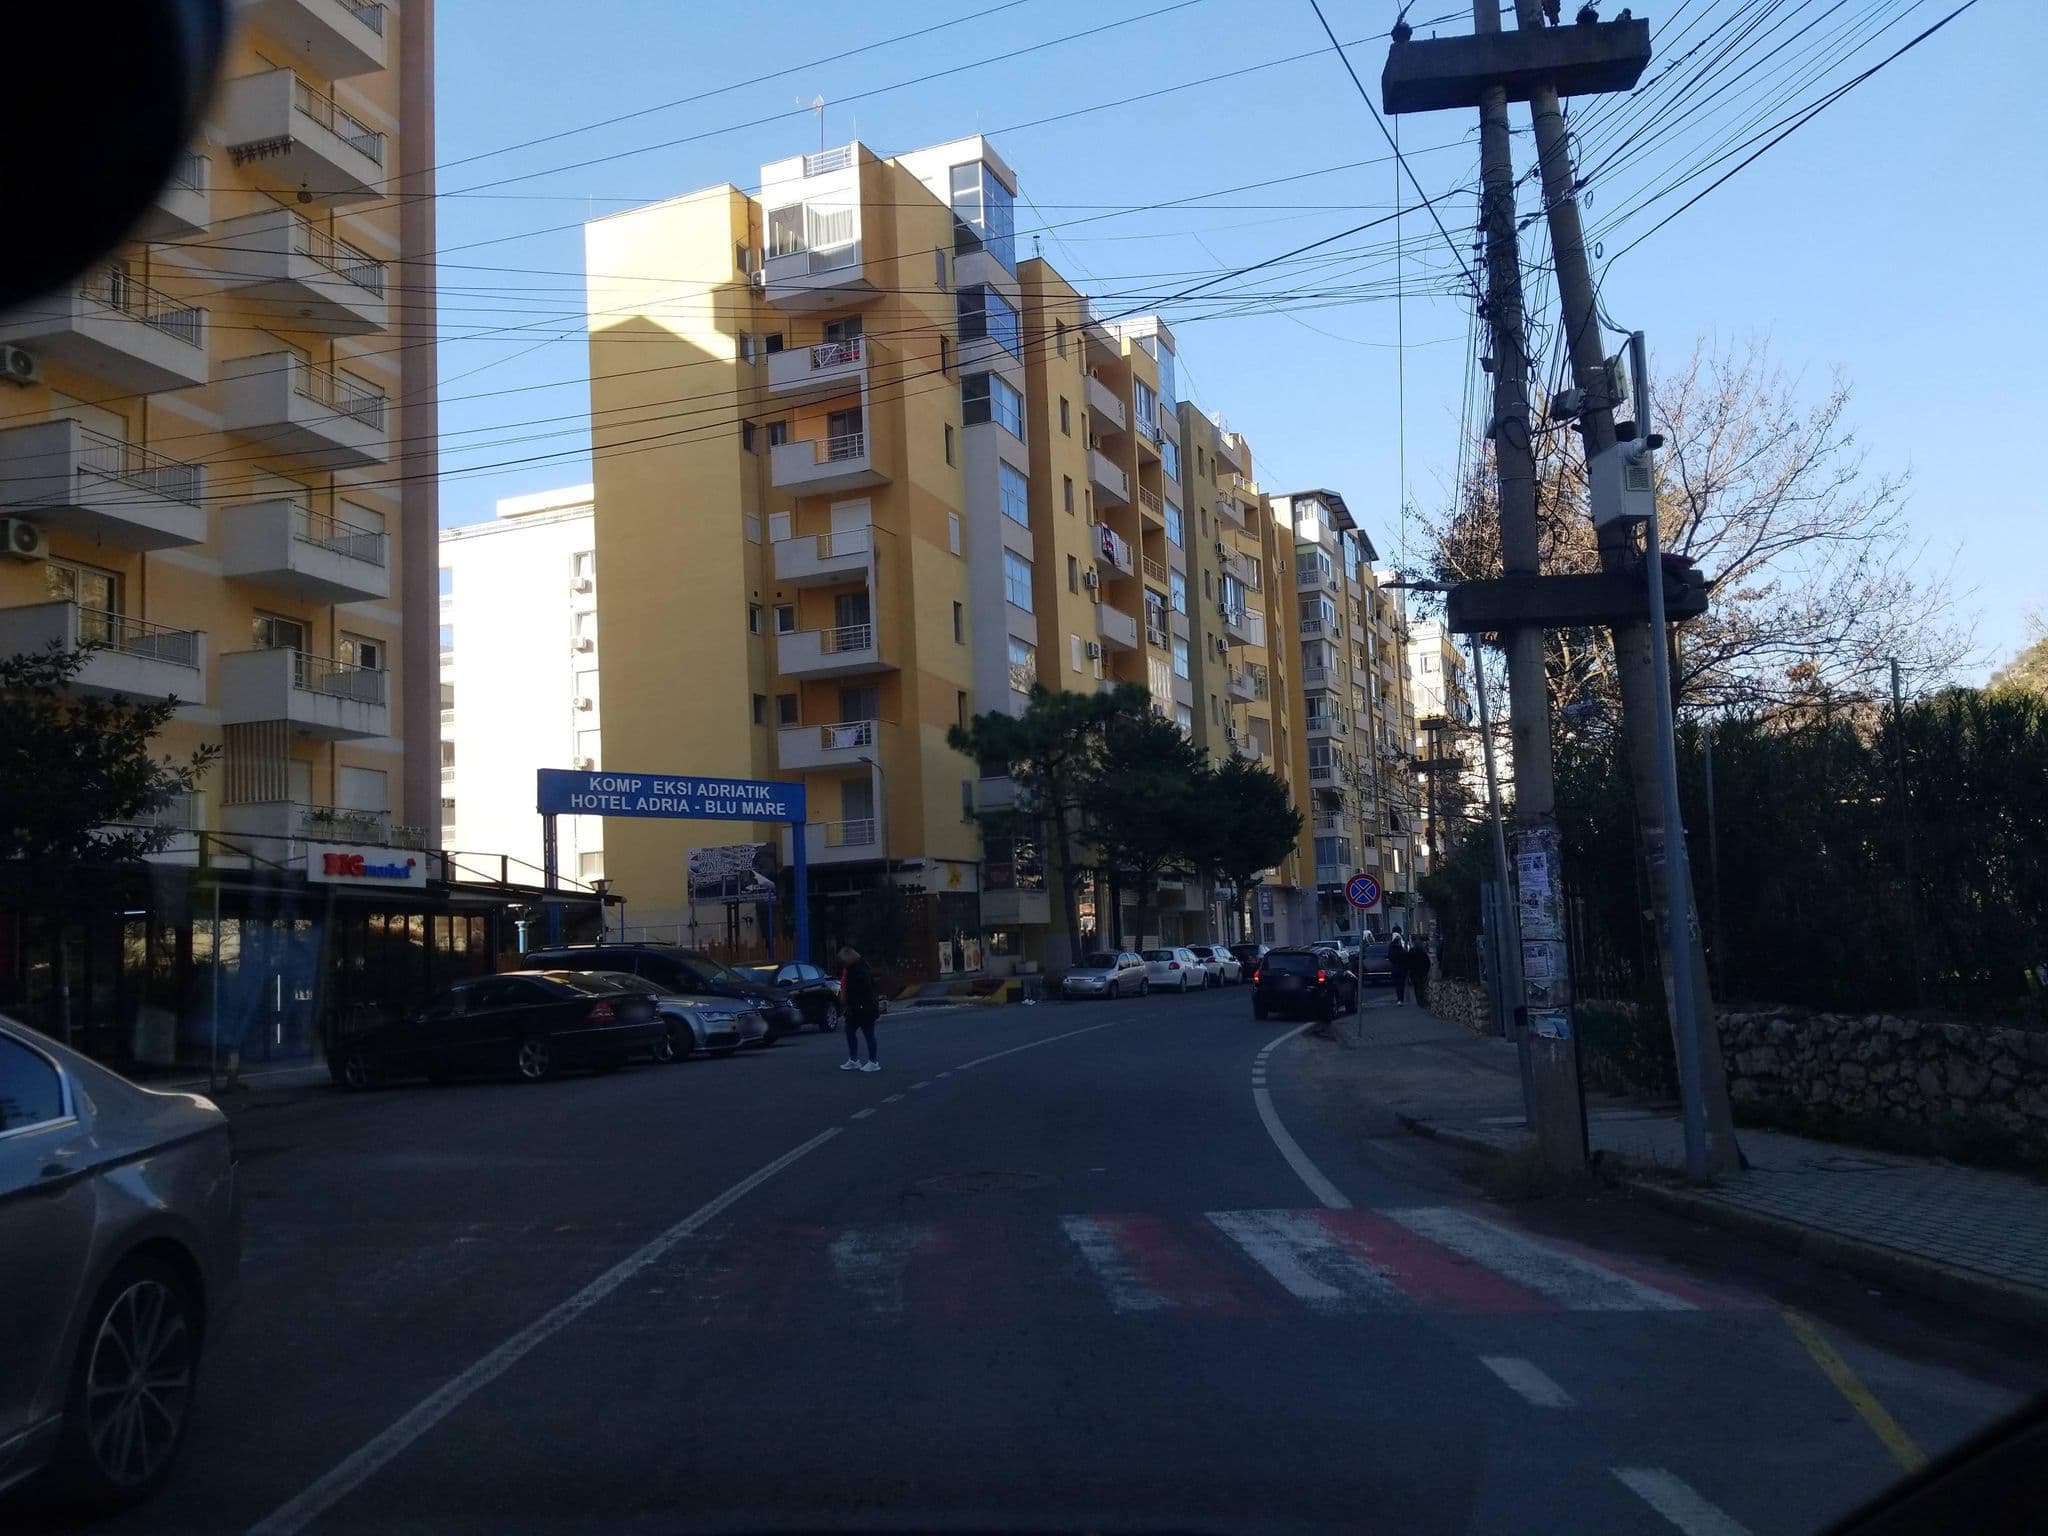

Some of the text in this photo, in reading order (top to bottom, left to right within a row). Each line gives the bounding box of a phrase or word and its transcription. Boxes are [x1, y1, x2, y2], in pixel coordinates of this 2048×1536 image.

[589, 777, 770, 799] KOMP EKSI ADRIATIK
[571, 793, 631, 811] HOTEL
[636, 797, 690, 813] ADRIA
[705, 800, 737, 814] BLU
[742, 801, 786, 816] MARE
